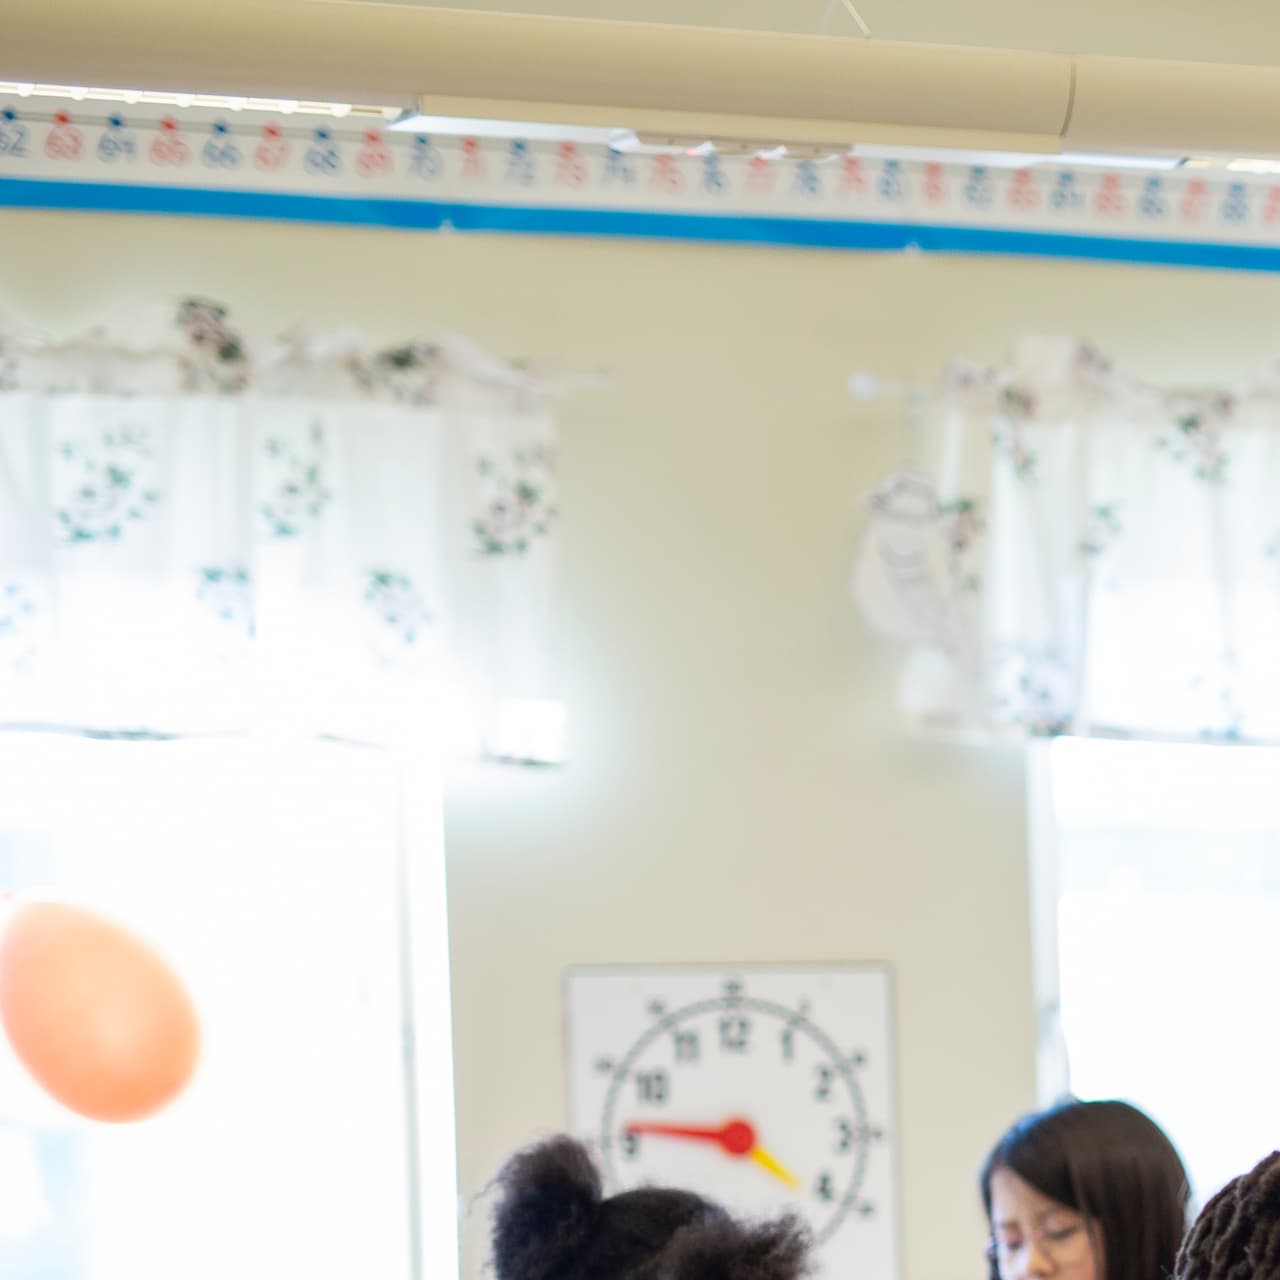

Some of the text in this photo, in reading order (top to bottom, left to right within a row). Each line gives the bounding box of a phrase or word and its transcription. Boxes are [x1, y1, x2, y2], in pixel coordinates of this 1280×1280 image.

[674, 1031, 699, 1064] 11
[720, 1017, 749, 1052] 12
[781, 1028, 794, 1063] 1
[636, 1069, 668, 1103] 10
[816, 1065, 833, 1101] 2
[836, 1116, 851, 1152] 3
